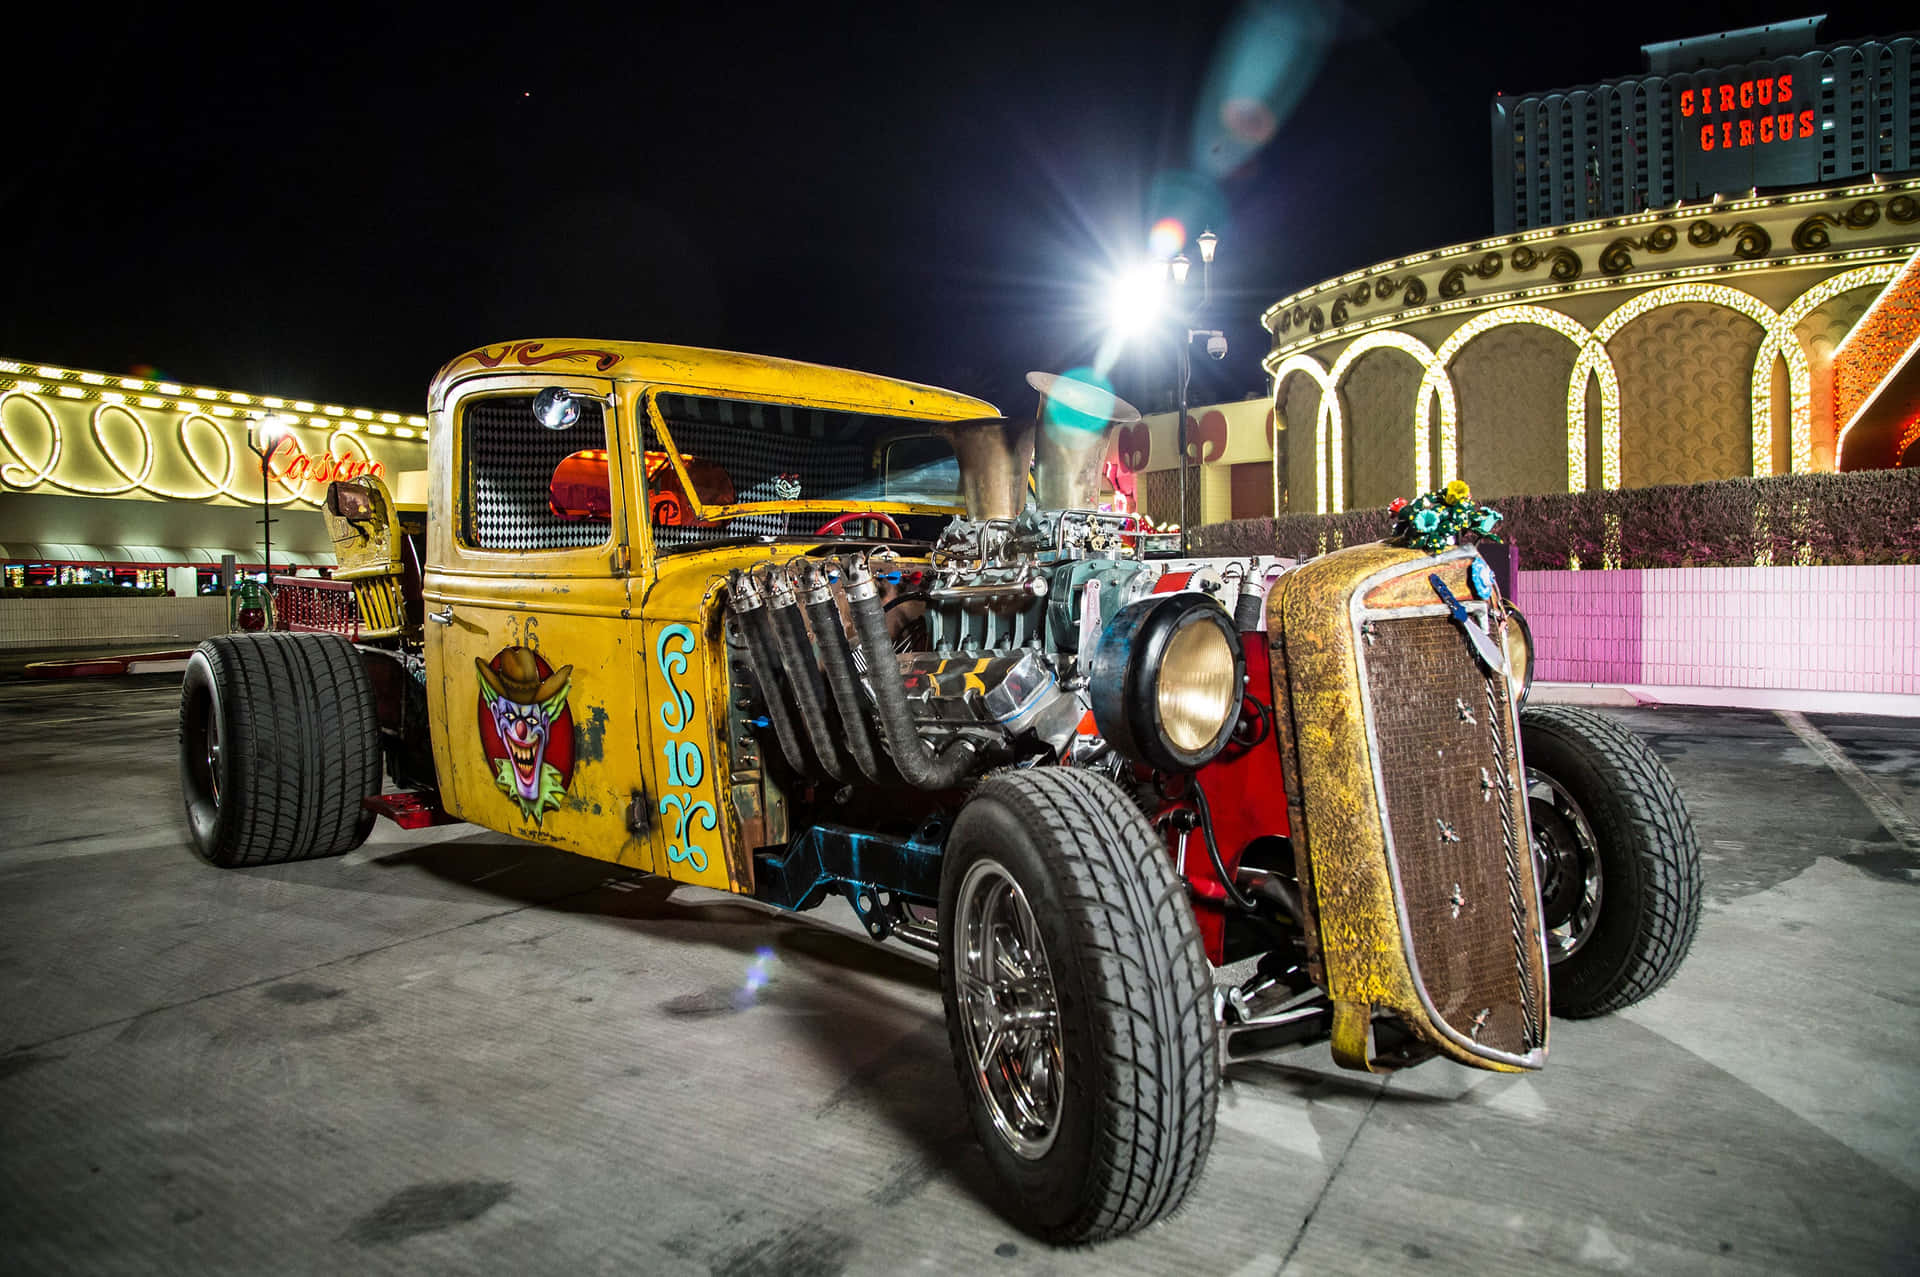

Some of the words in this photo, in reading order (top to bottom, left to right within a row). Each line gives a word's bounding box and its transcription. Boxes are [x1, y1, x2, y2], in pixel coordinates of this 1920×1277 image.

[1680, 74, 1792, 117] CIRCUS
[1700, 109, 1815, 151] CIRCUS
[260, 434, 386, 484] Casino
[663, 739, 704, 788] 10
